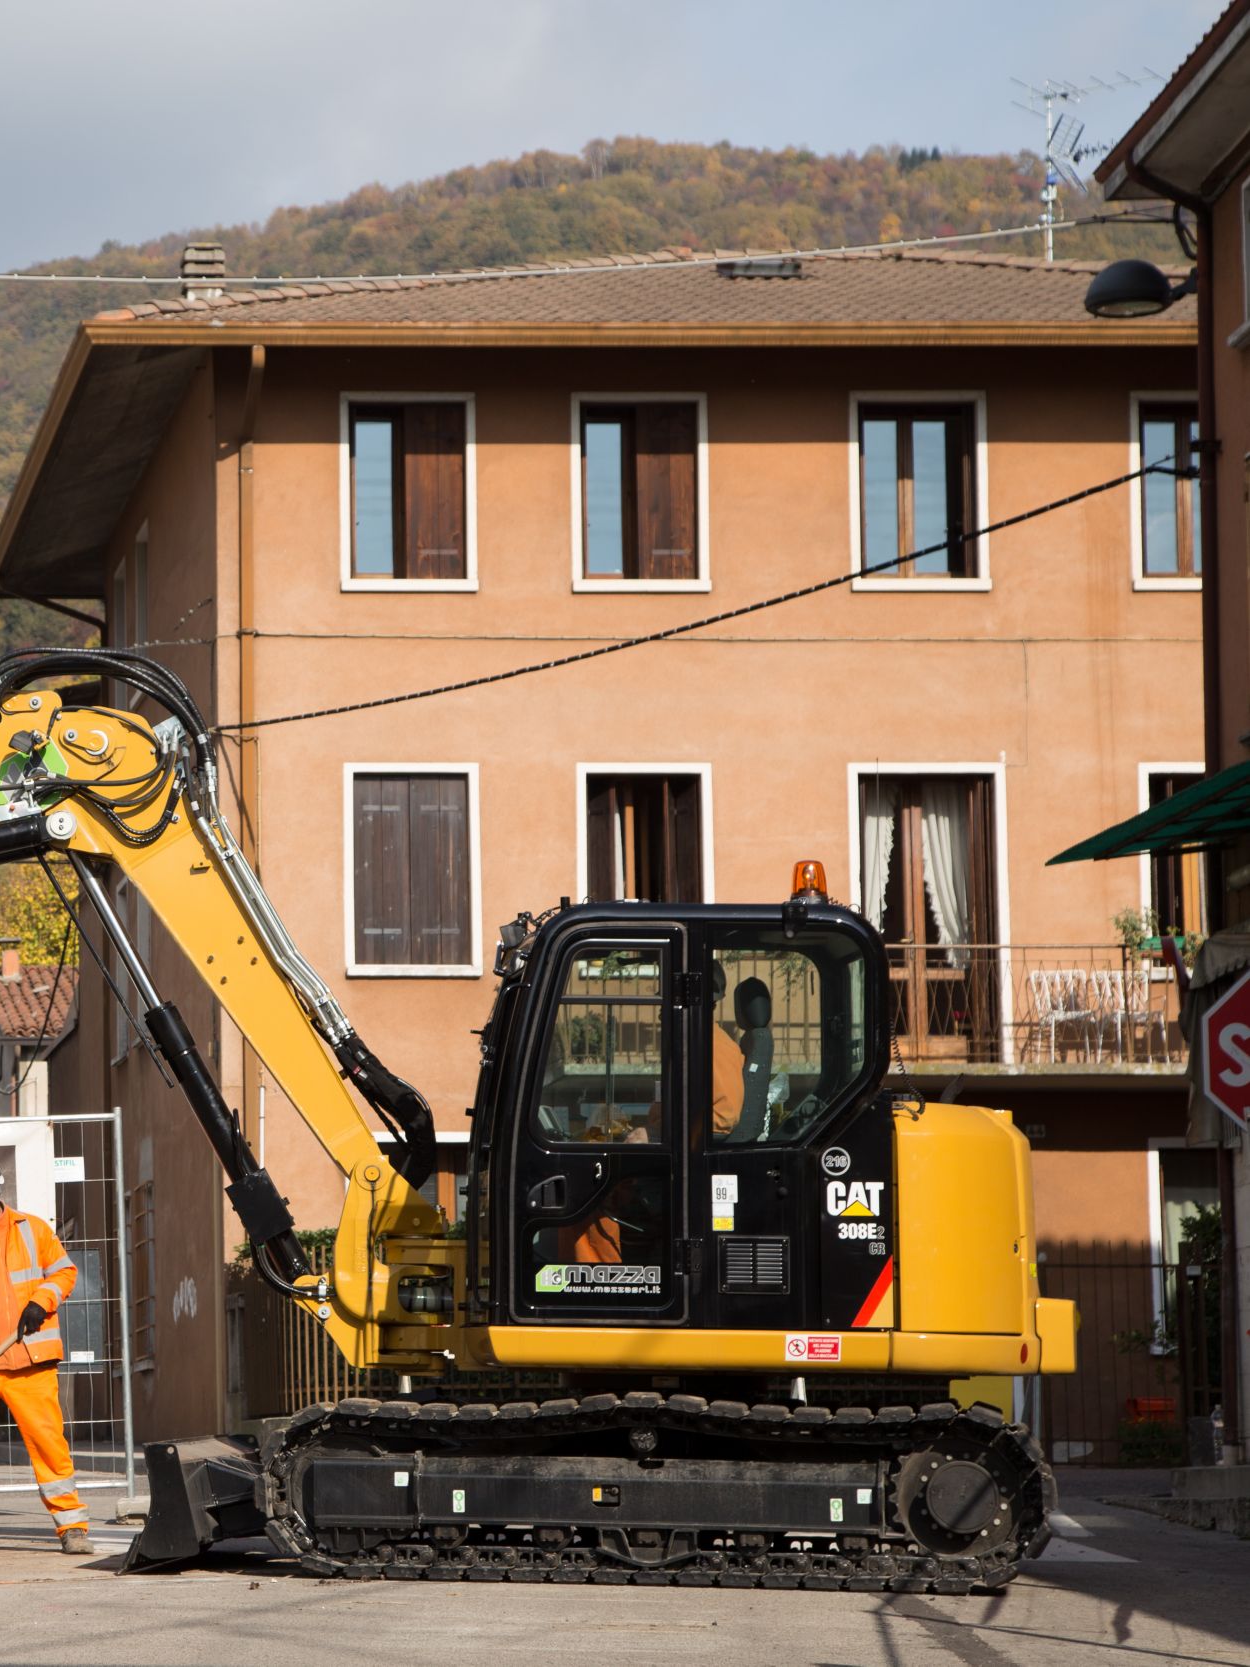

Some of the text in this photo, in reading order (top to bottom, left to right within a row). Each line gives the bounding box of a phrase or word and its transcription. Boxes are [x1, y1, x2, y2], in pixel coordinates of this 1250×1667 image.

[825, 1155, 848, 1168] 216
[715, 1187, 727, 1200] 99
[826, 1180, 885, 1217] CAT
[868, 1241, 886, 1255] CR
[564, 1265, 661, 1284] mazza
[563, 1285, 661, 1294] www.mazzasrl.it
